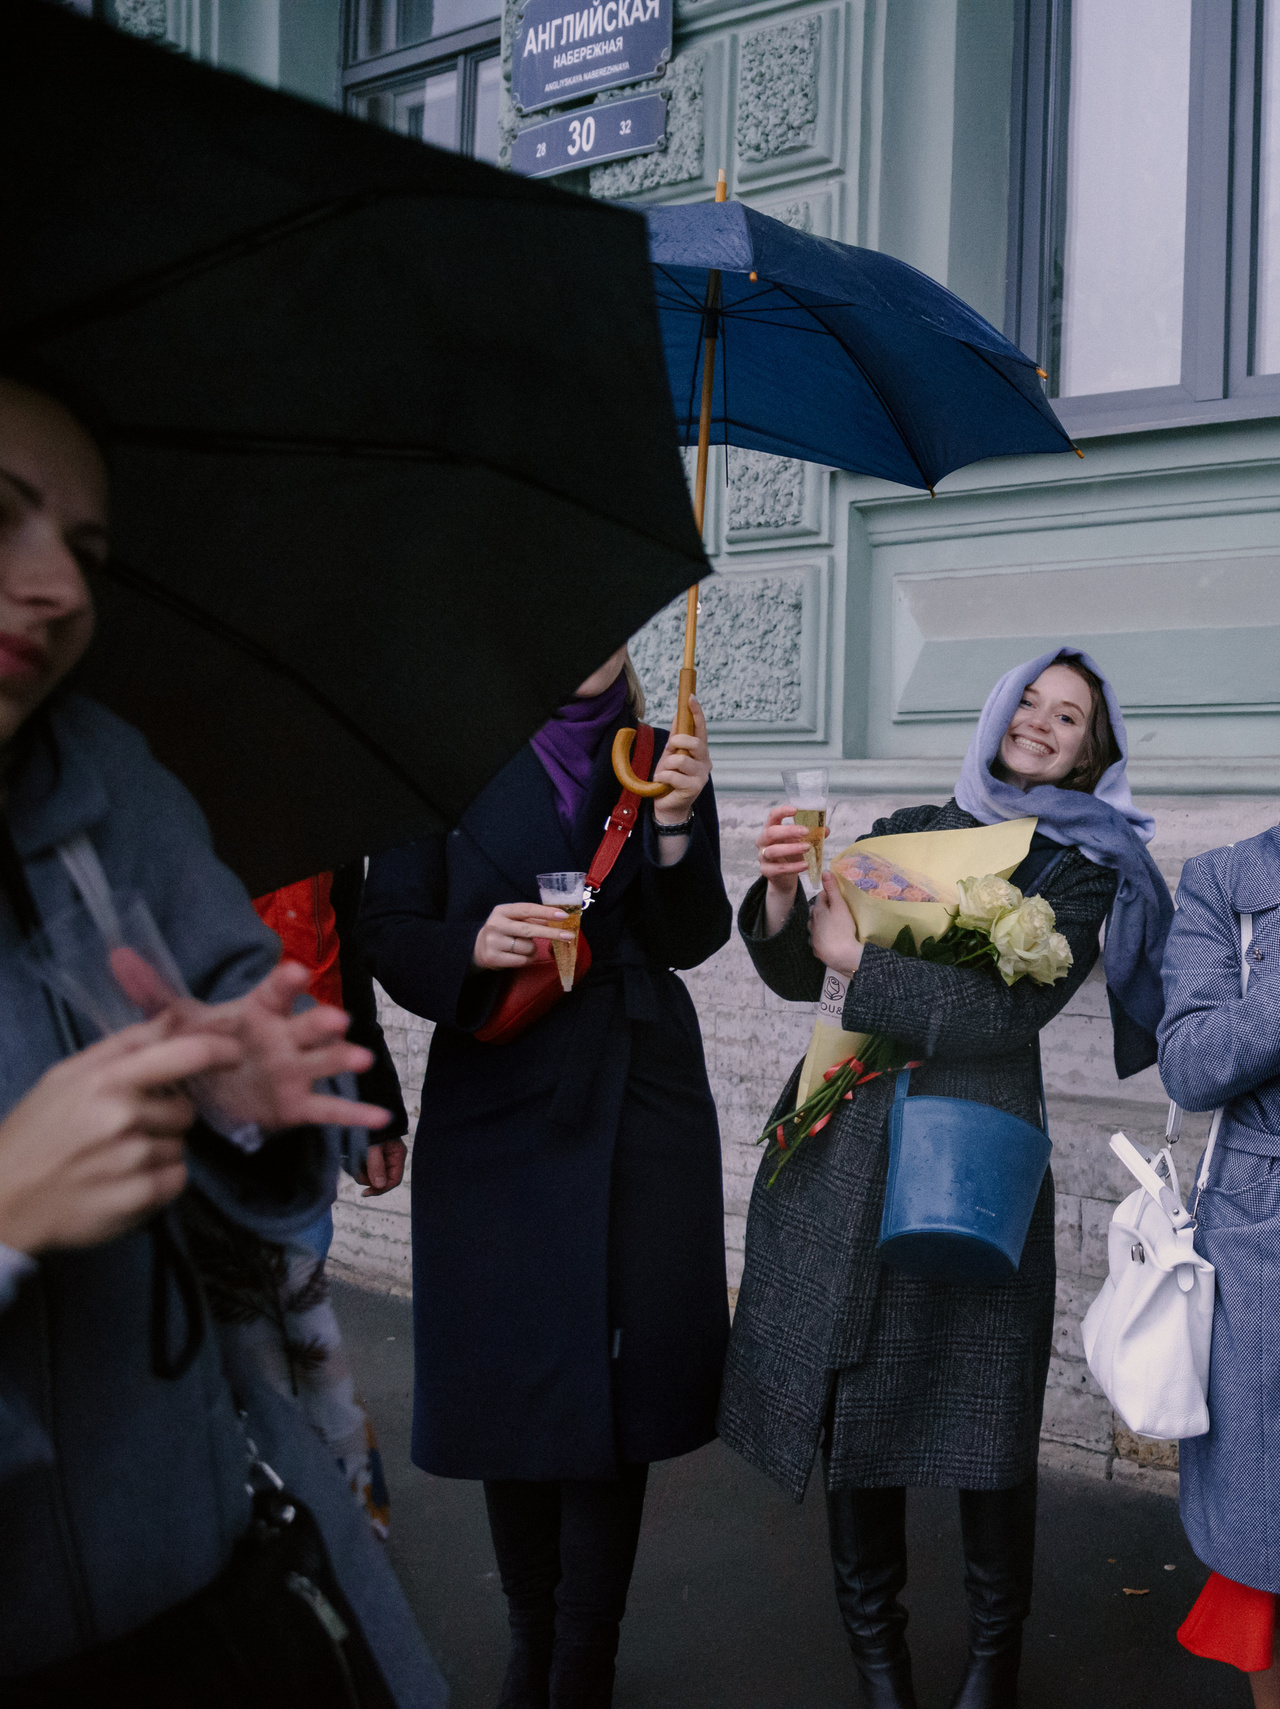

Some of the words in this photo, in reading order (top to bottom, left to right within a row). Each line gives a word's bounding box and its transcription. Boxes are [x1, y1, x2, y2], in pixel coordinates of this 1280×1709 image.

[523, 0, 660, 57] АНГЛИЙСКАЯ
[553, 36, 624, 69] НАБЕРЕЖНАЯ
[535, 142, 547, 158] 28
[567, 116, 596, 156] 30
[619, 119, 632, 135] 32
